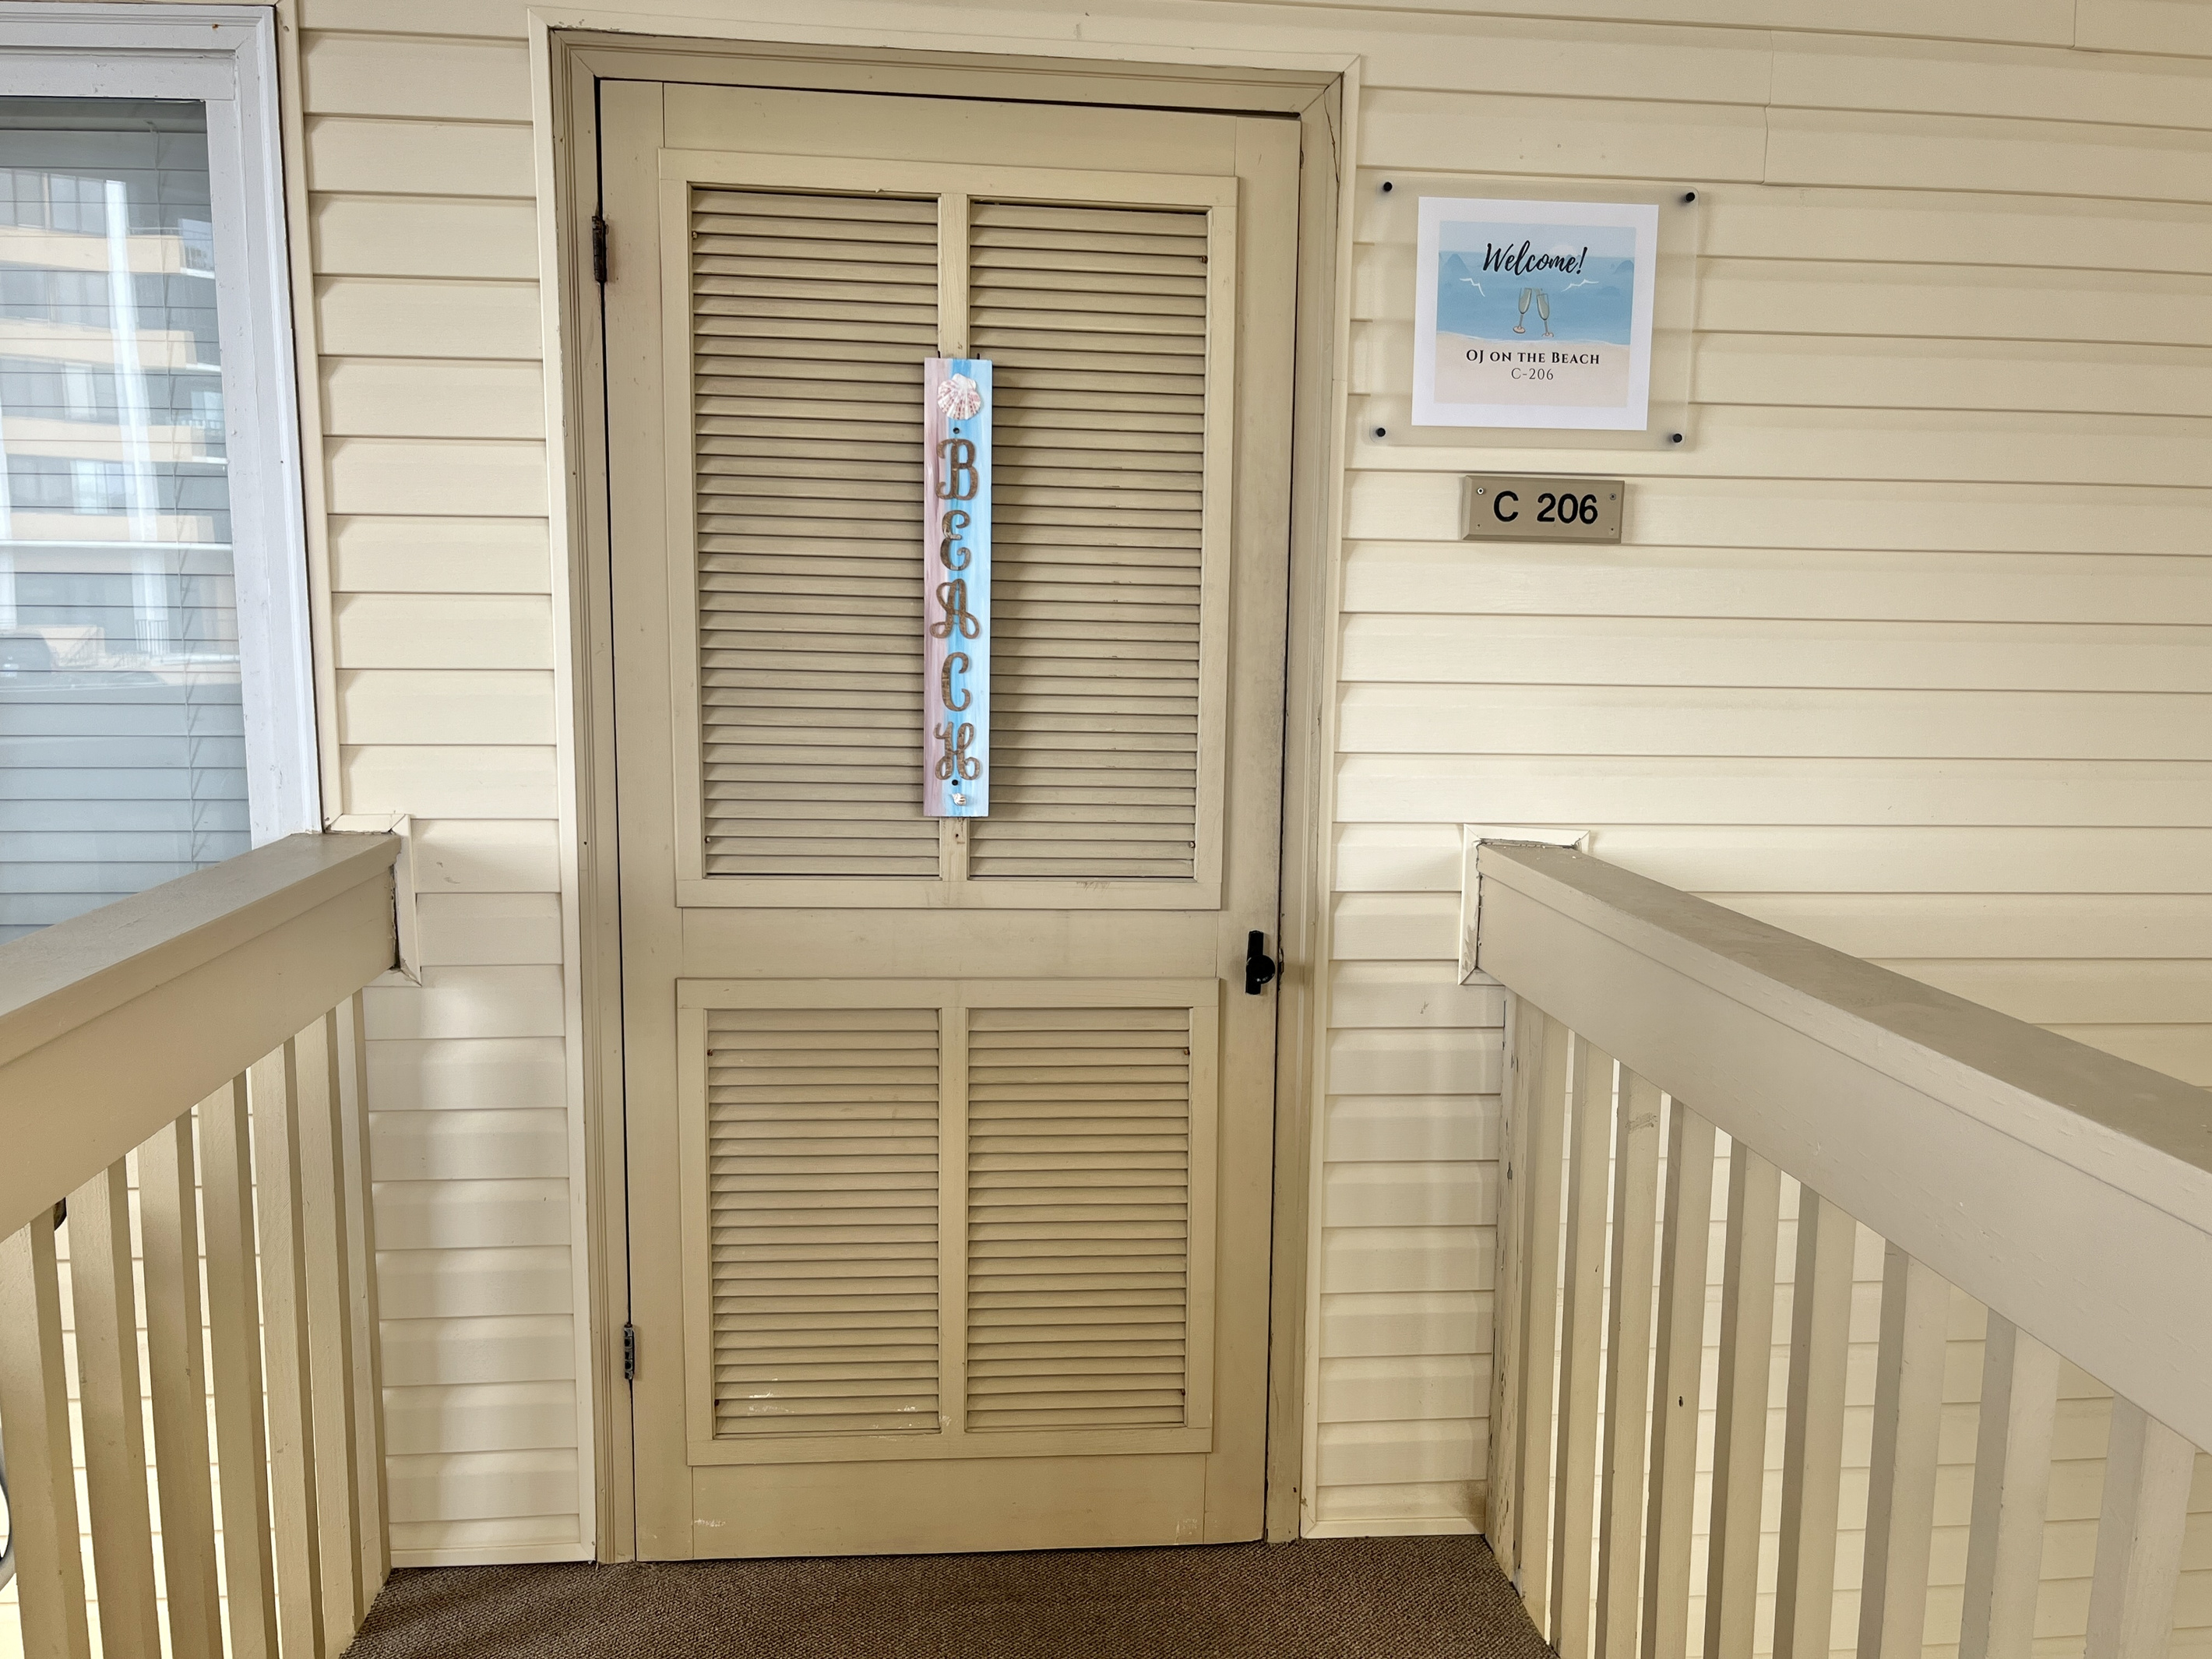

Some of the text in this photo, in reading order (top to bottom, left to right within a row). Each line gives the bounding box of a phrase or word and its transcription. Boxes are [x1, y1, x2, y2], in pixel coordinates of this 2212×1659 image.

[1482, 240, 1587, 276] Welcome!
[1466, 349, 1600, 365] OJ ON THE BEACH
[1510, 368, 1555, 380] C-206
[1493, 491, 1598, 524] C 206
[930, 437, 981, 780] BEACH
